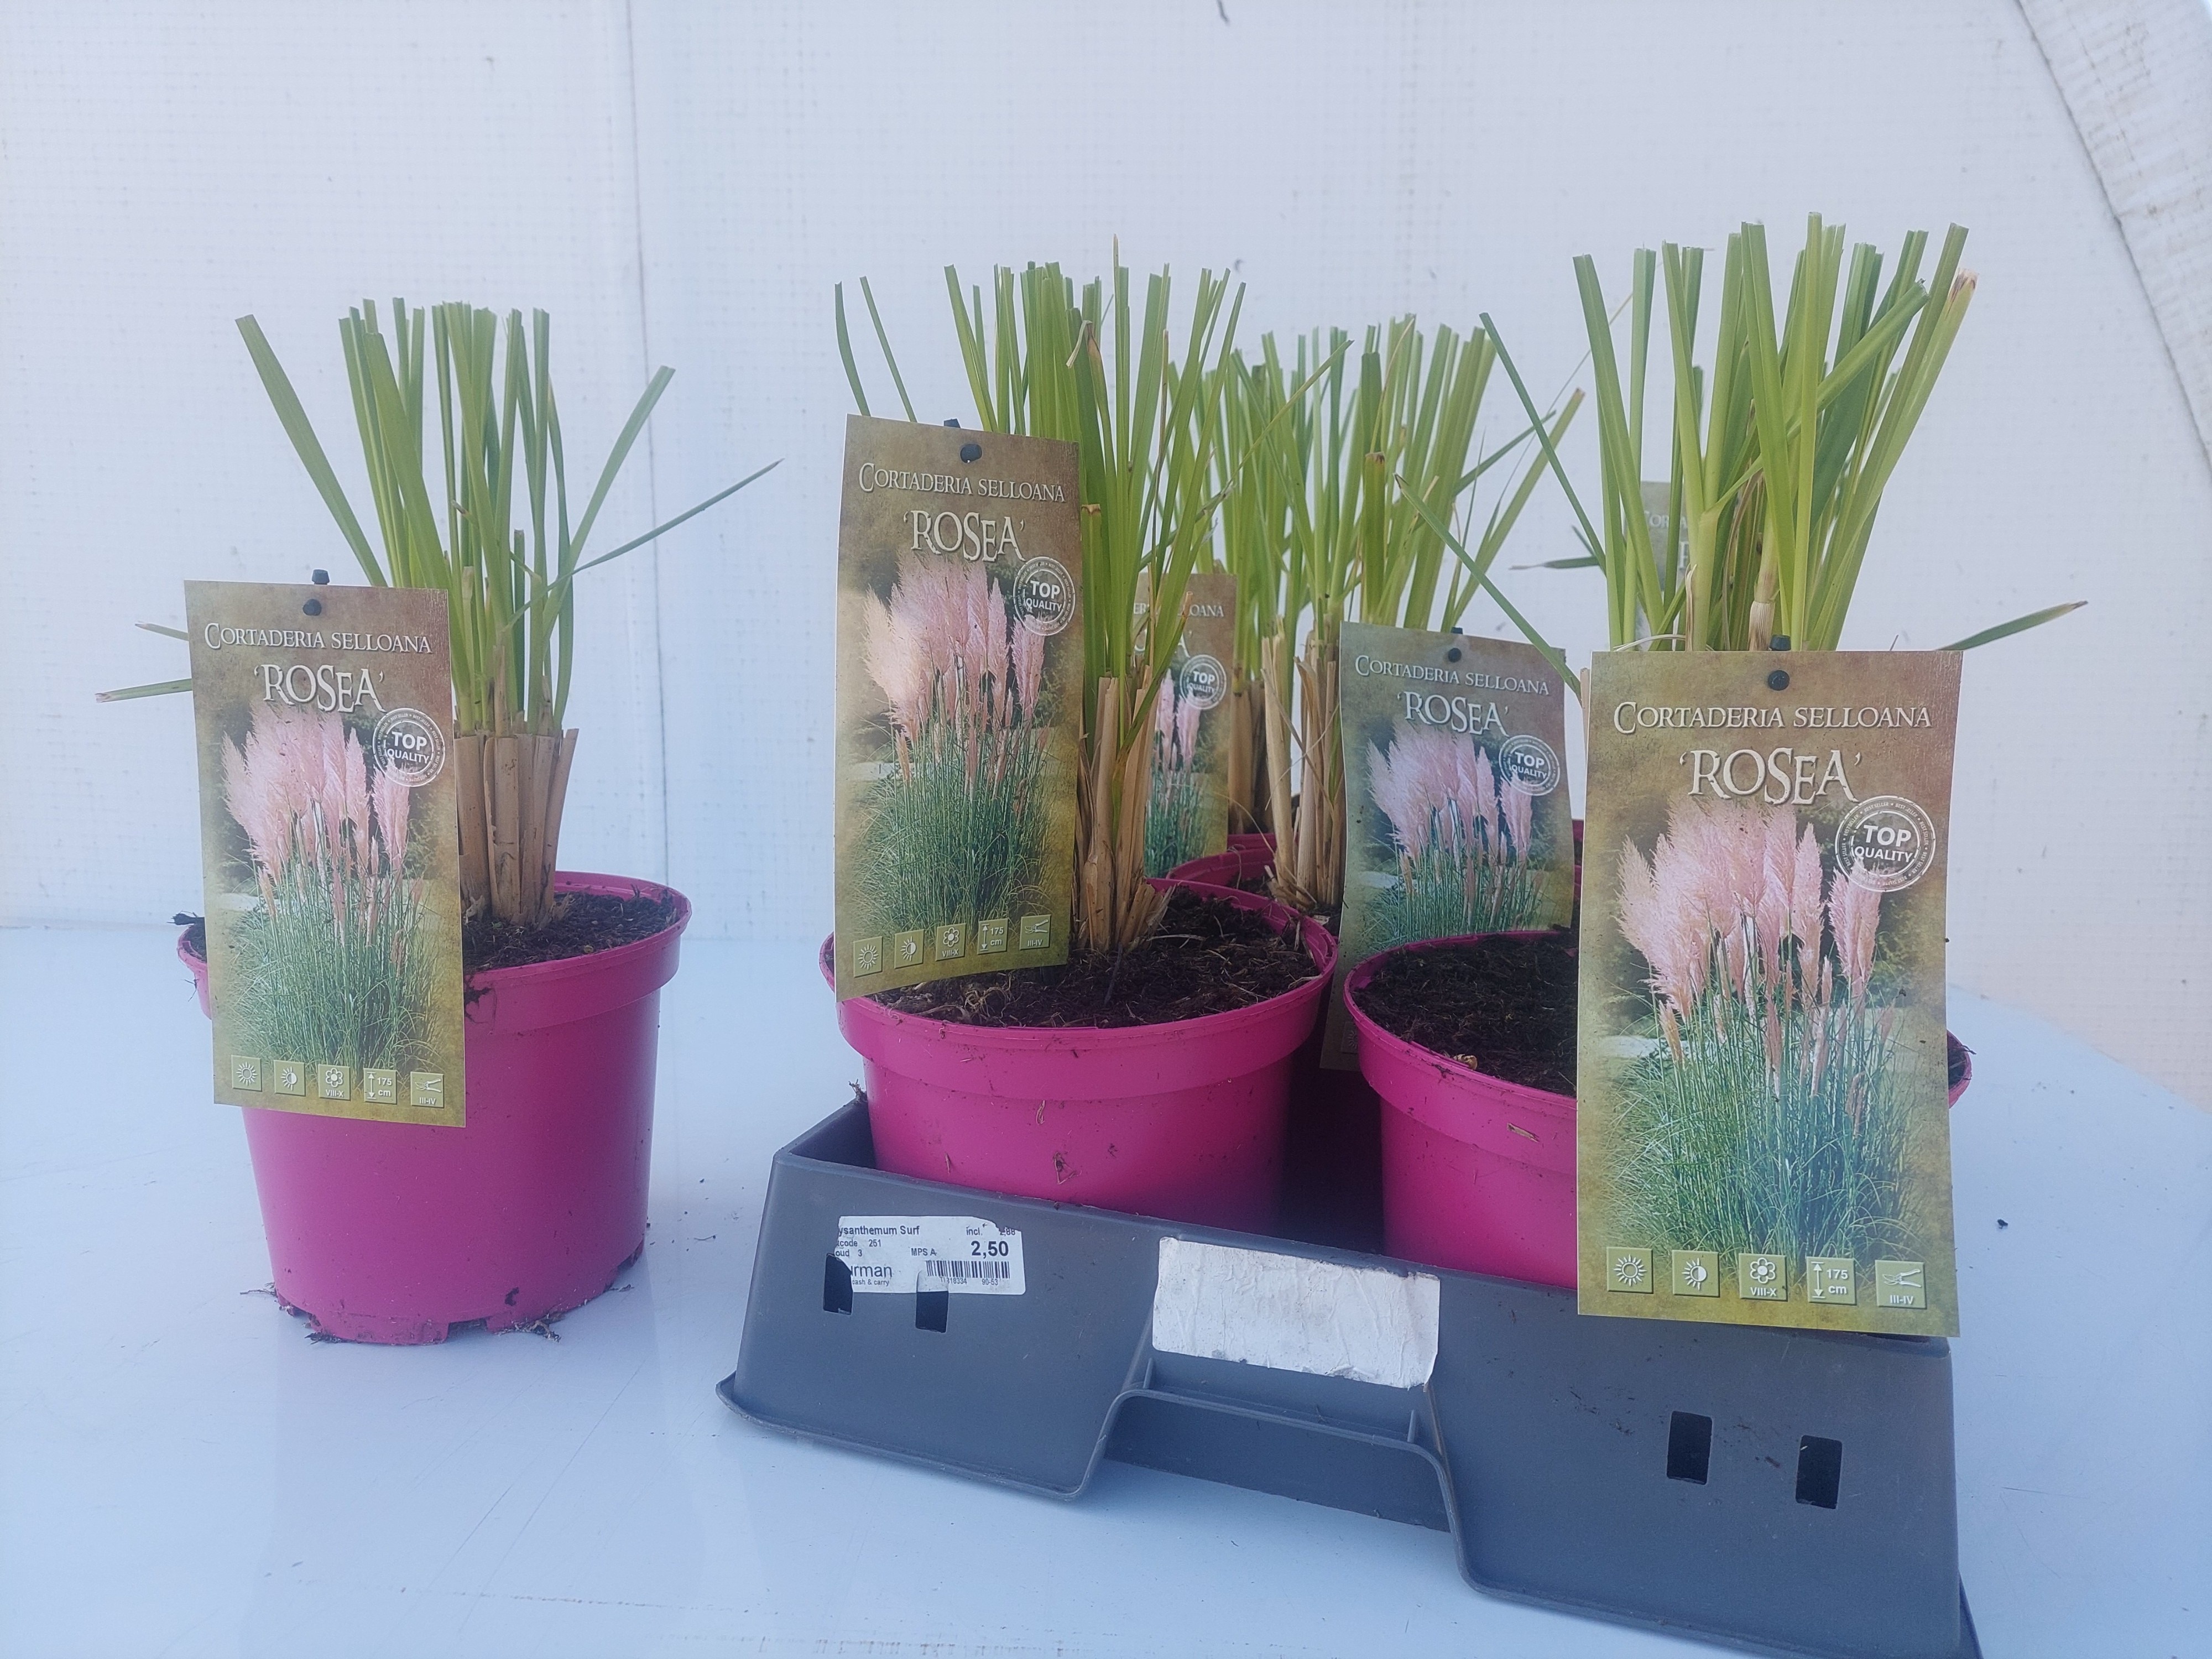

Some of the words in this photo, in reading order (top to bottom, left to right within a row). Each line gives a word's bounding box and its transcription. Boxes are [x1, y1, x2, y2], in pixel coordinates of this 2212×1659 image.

[859, 463, 973, 495] CORTADERIA
[978, 478, 1066, 503] SELLOANA
[1030, 580, 1060, 599] TOP
[1026, 598, 1062, 612] QUALITY
[205, 623, 326, 649] CORTADERIA
[331, 633, 432, 654] SELLOANA
[1193, 671, 1215, 683] TOP
[1355, 655, 1459, 685] CORTADERIA
[1465, 672, 1549, 695] SELLOANA
[1190, 683, 1217, 692] QUALITY
[1614, 701, 1785, 734] CORTADERIA
[1793, 706, 1932, 728] SELLOANA
[392, 731, 427, 750] TOP
[387, 749, 429, 764] QUALITY
[1515, 752, 1545, 768] TOP
[1511, 765, 1547, 779] QUALITY
[1864, 825, 1911, 847] TOP
[1855, 846, 1913, 862] QUALITY
[942, 949, 959, 957] VIII-X
[326, 1089, 344, 1098] VIII-X
[900, 1225, 920, 1235] Surf
[971, 1241, 1009, 1259] 2,50
[1827, 1269, 1848, 1280] 175
[1750, 1287, 1777, 1297] VIII-X
[1828, 1285, 1846, 1295] cm
[1890, 1295, 1913, 1305] III-IV
